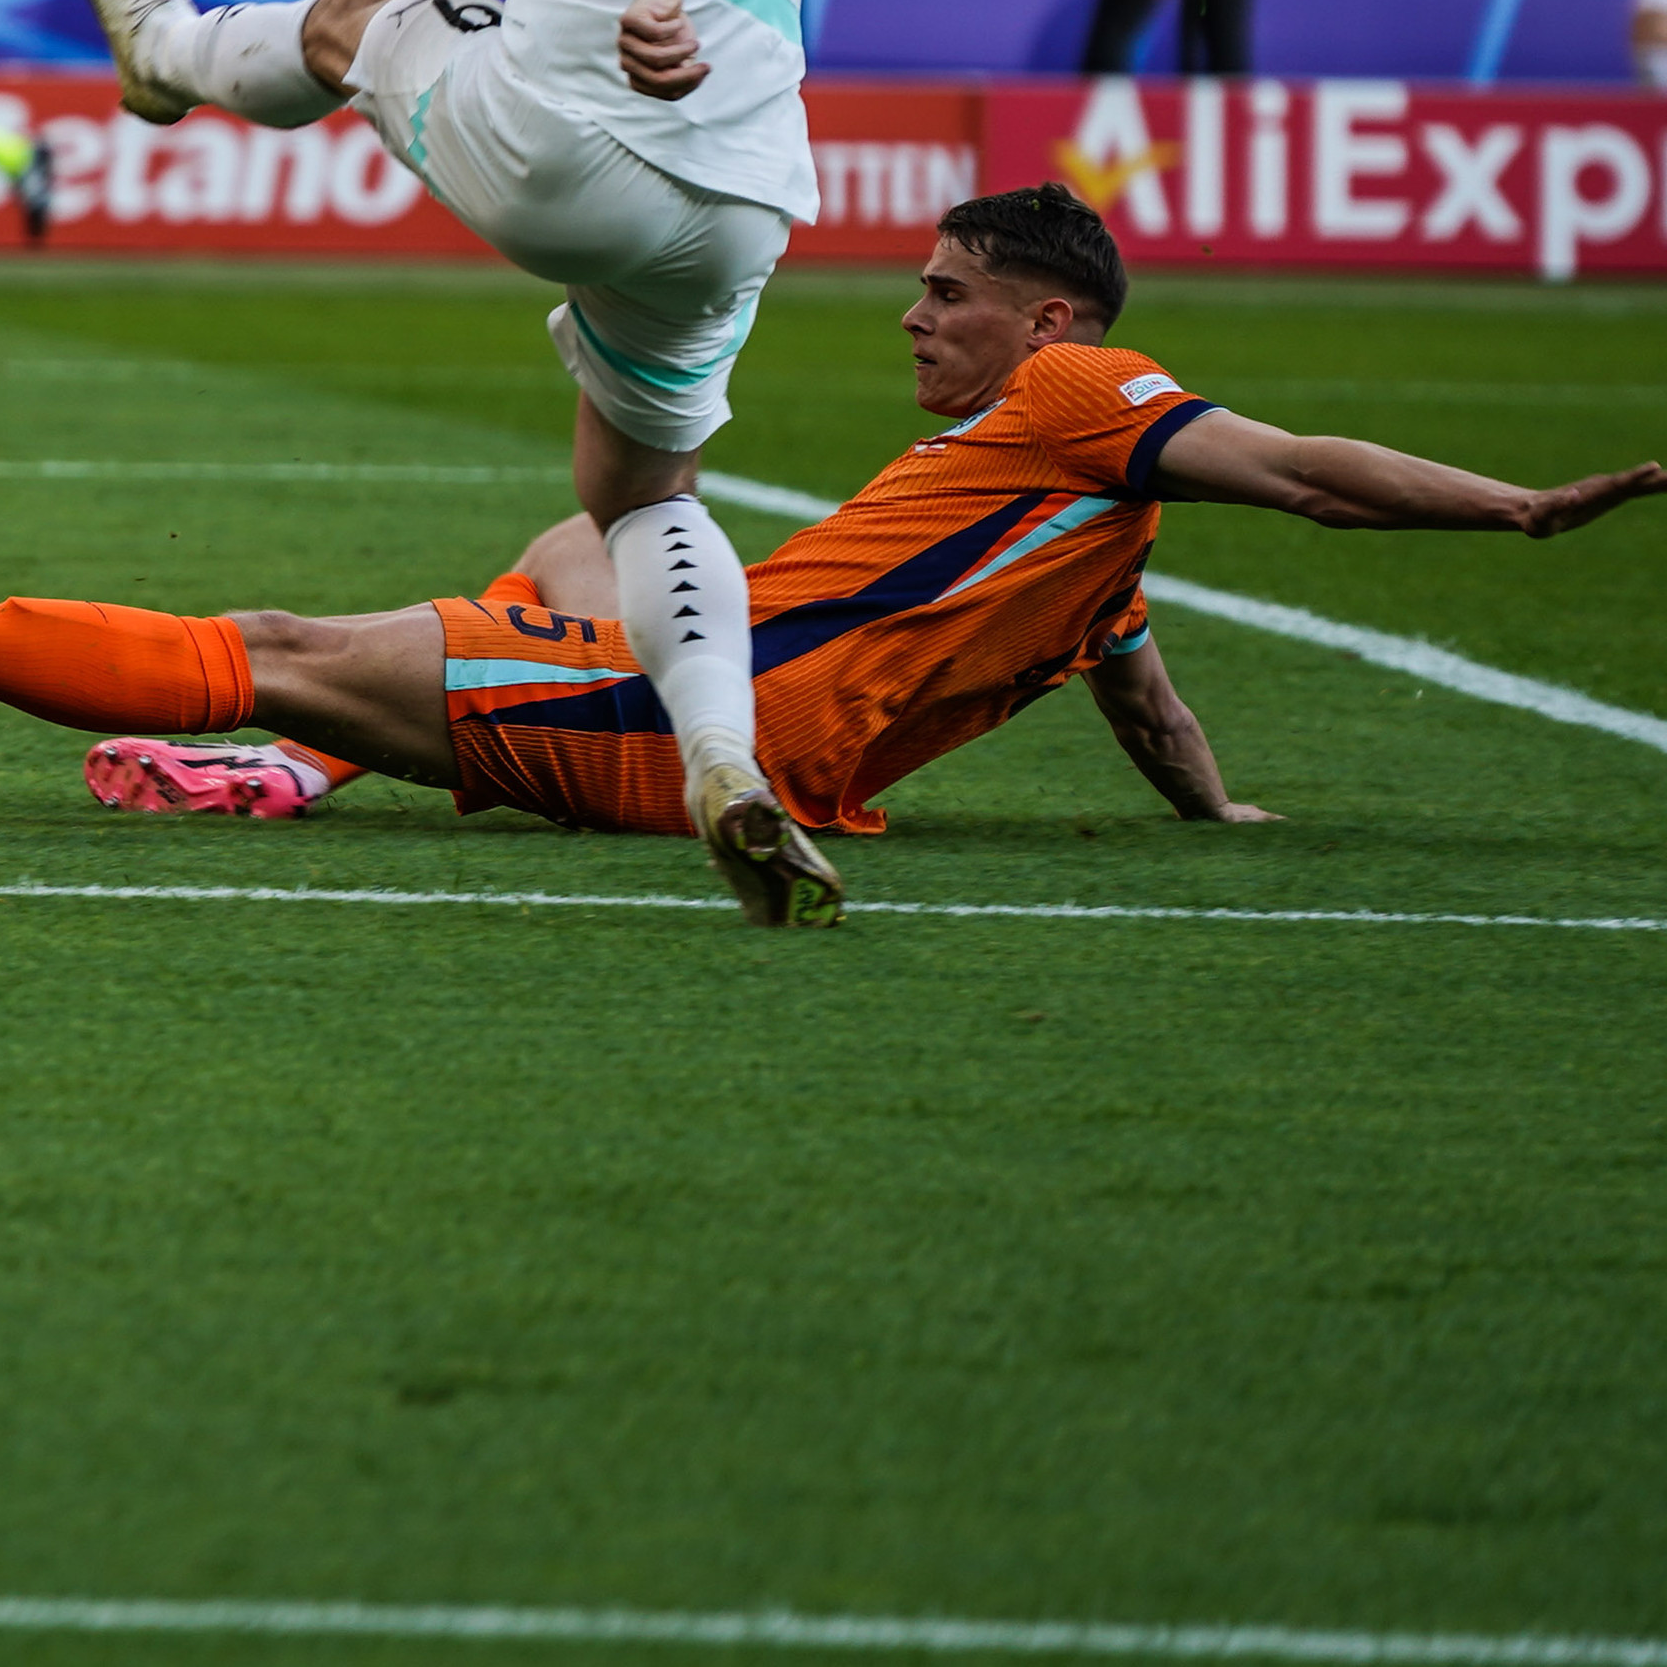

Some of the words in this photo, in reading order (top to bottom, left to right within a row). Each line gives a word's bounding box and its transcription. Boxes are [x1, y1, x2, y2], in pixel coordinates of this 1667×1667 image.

[816, 141, 976, 226] TTEN
[1069, 75, 1667, 281] AliExp
[1127, 379, 1162, 399] FOUN
[506, 605, 597, 644] 5
